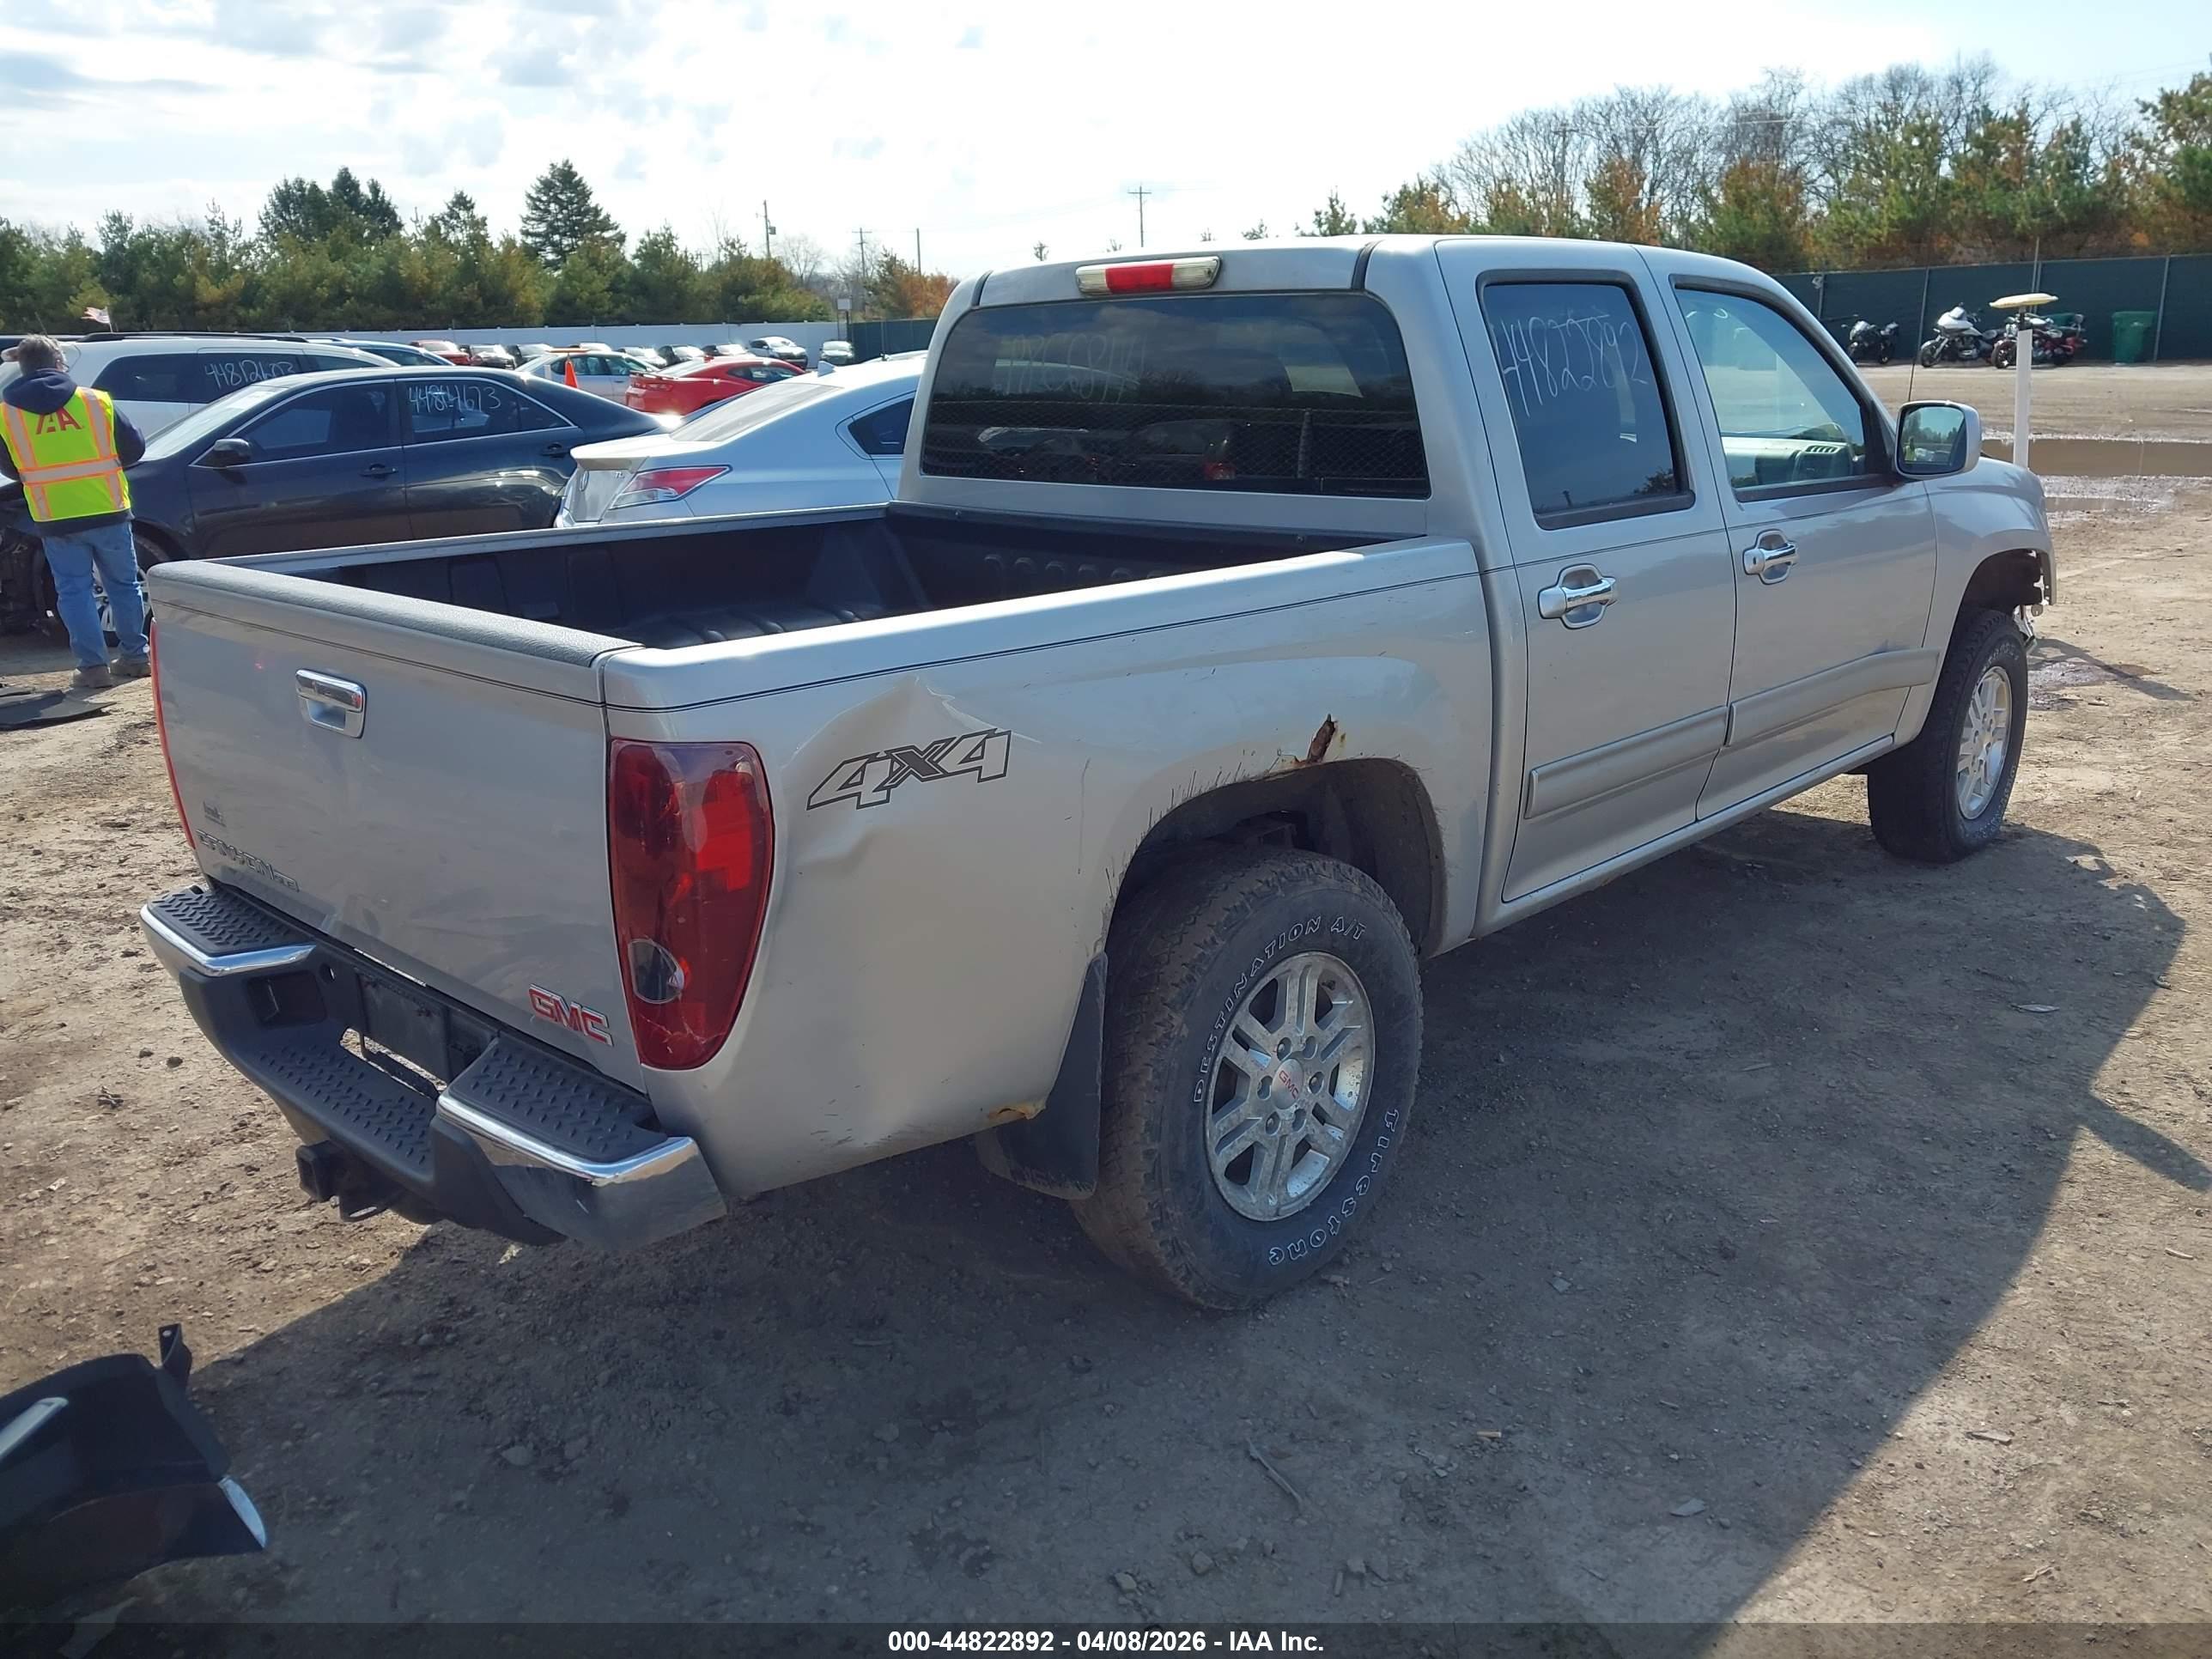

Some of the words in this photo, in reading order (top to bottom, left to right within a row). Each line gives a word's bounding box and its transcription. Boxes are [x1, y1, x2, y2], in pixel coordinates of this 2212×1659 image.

[528, 983, 615, 1047] GMC
[1194, 915, 1322, 1103] DESTINATION
[1331, 915, 1367, 941] A/T
[1279, 1070, 1299, 1100] GMC
